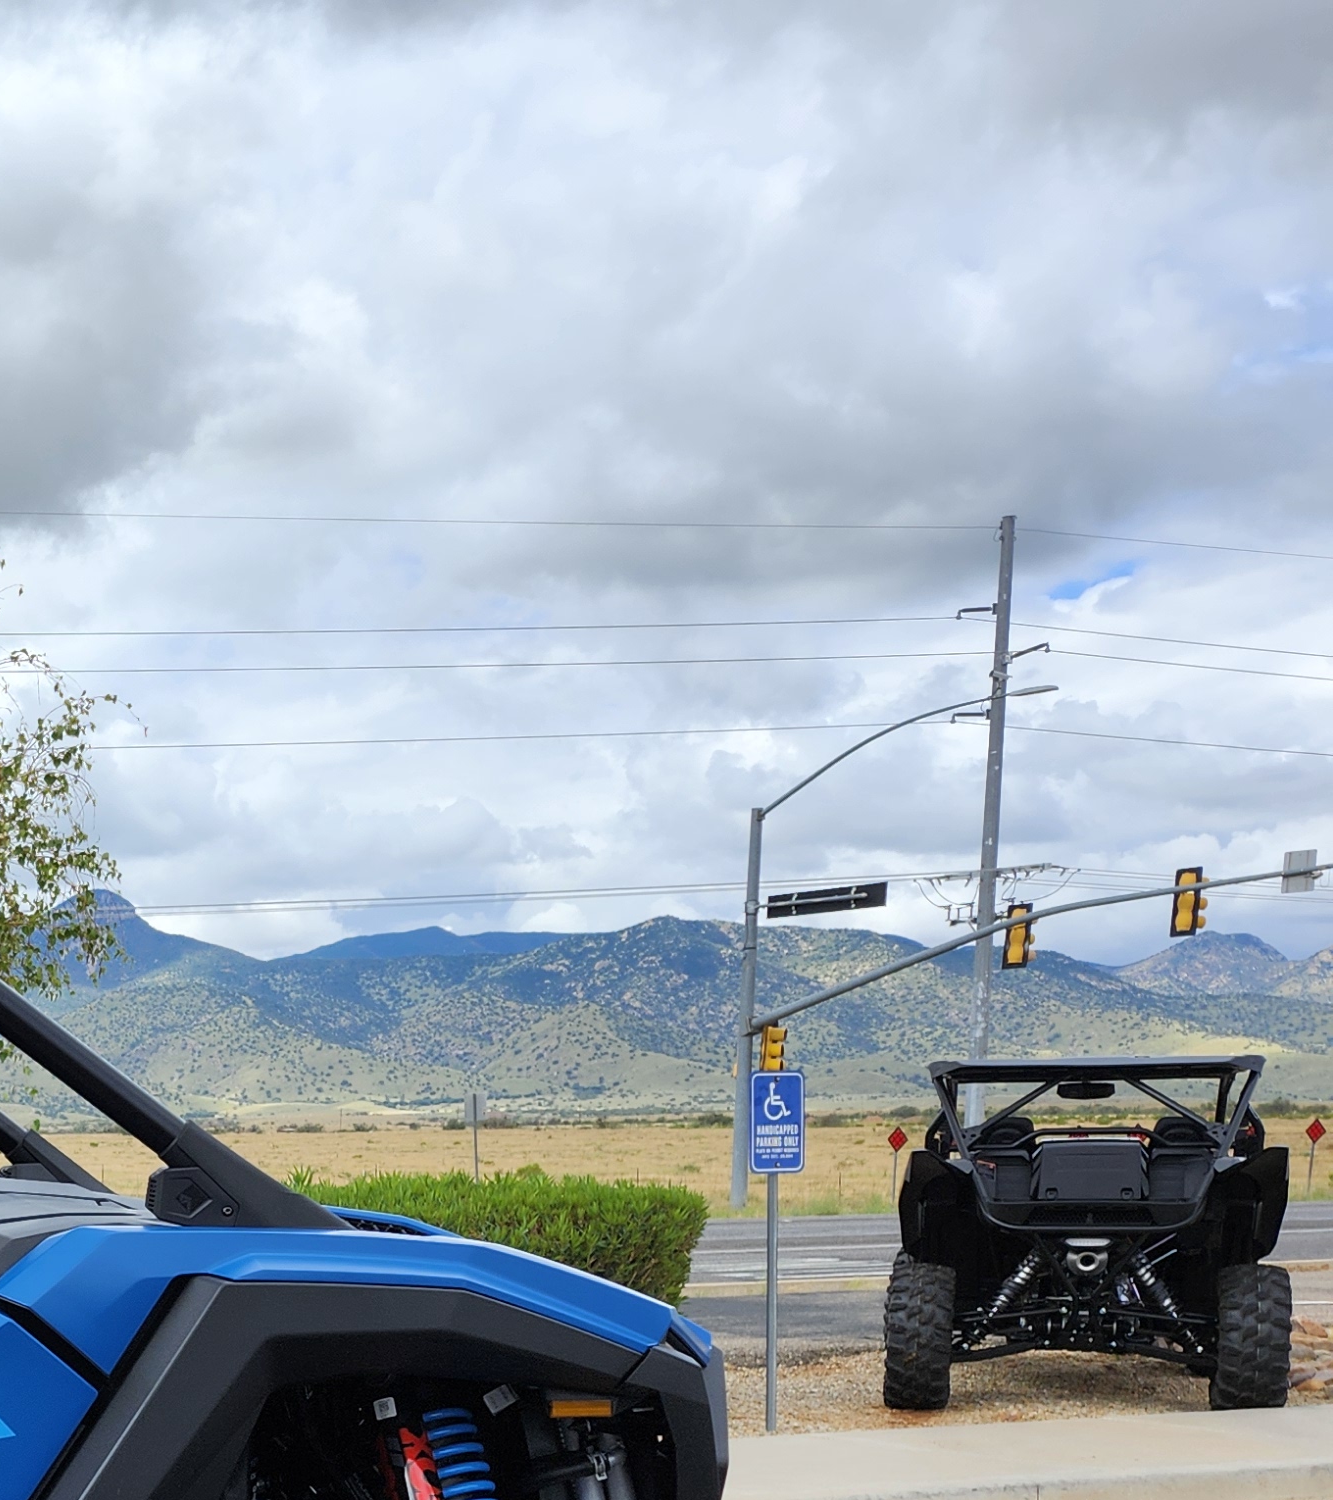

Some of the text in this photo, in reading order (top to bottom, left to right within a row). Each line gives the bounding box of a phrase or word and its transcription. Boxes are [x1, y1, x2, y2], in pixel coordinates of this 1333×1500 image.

[756, 1124, 799, 1135] HANDICAPPED
[756, 1135, 800, 1147] PARKING ONLY
